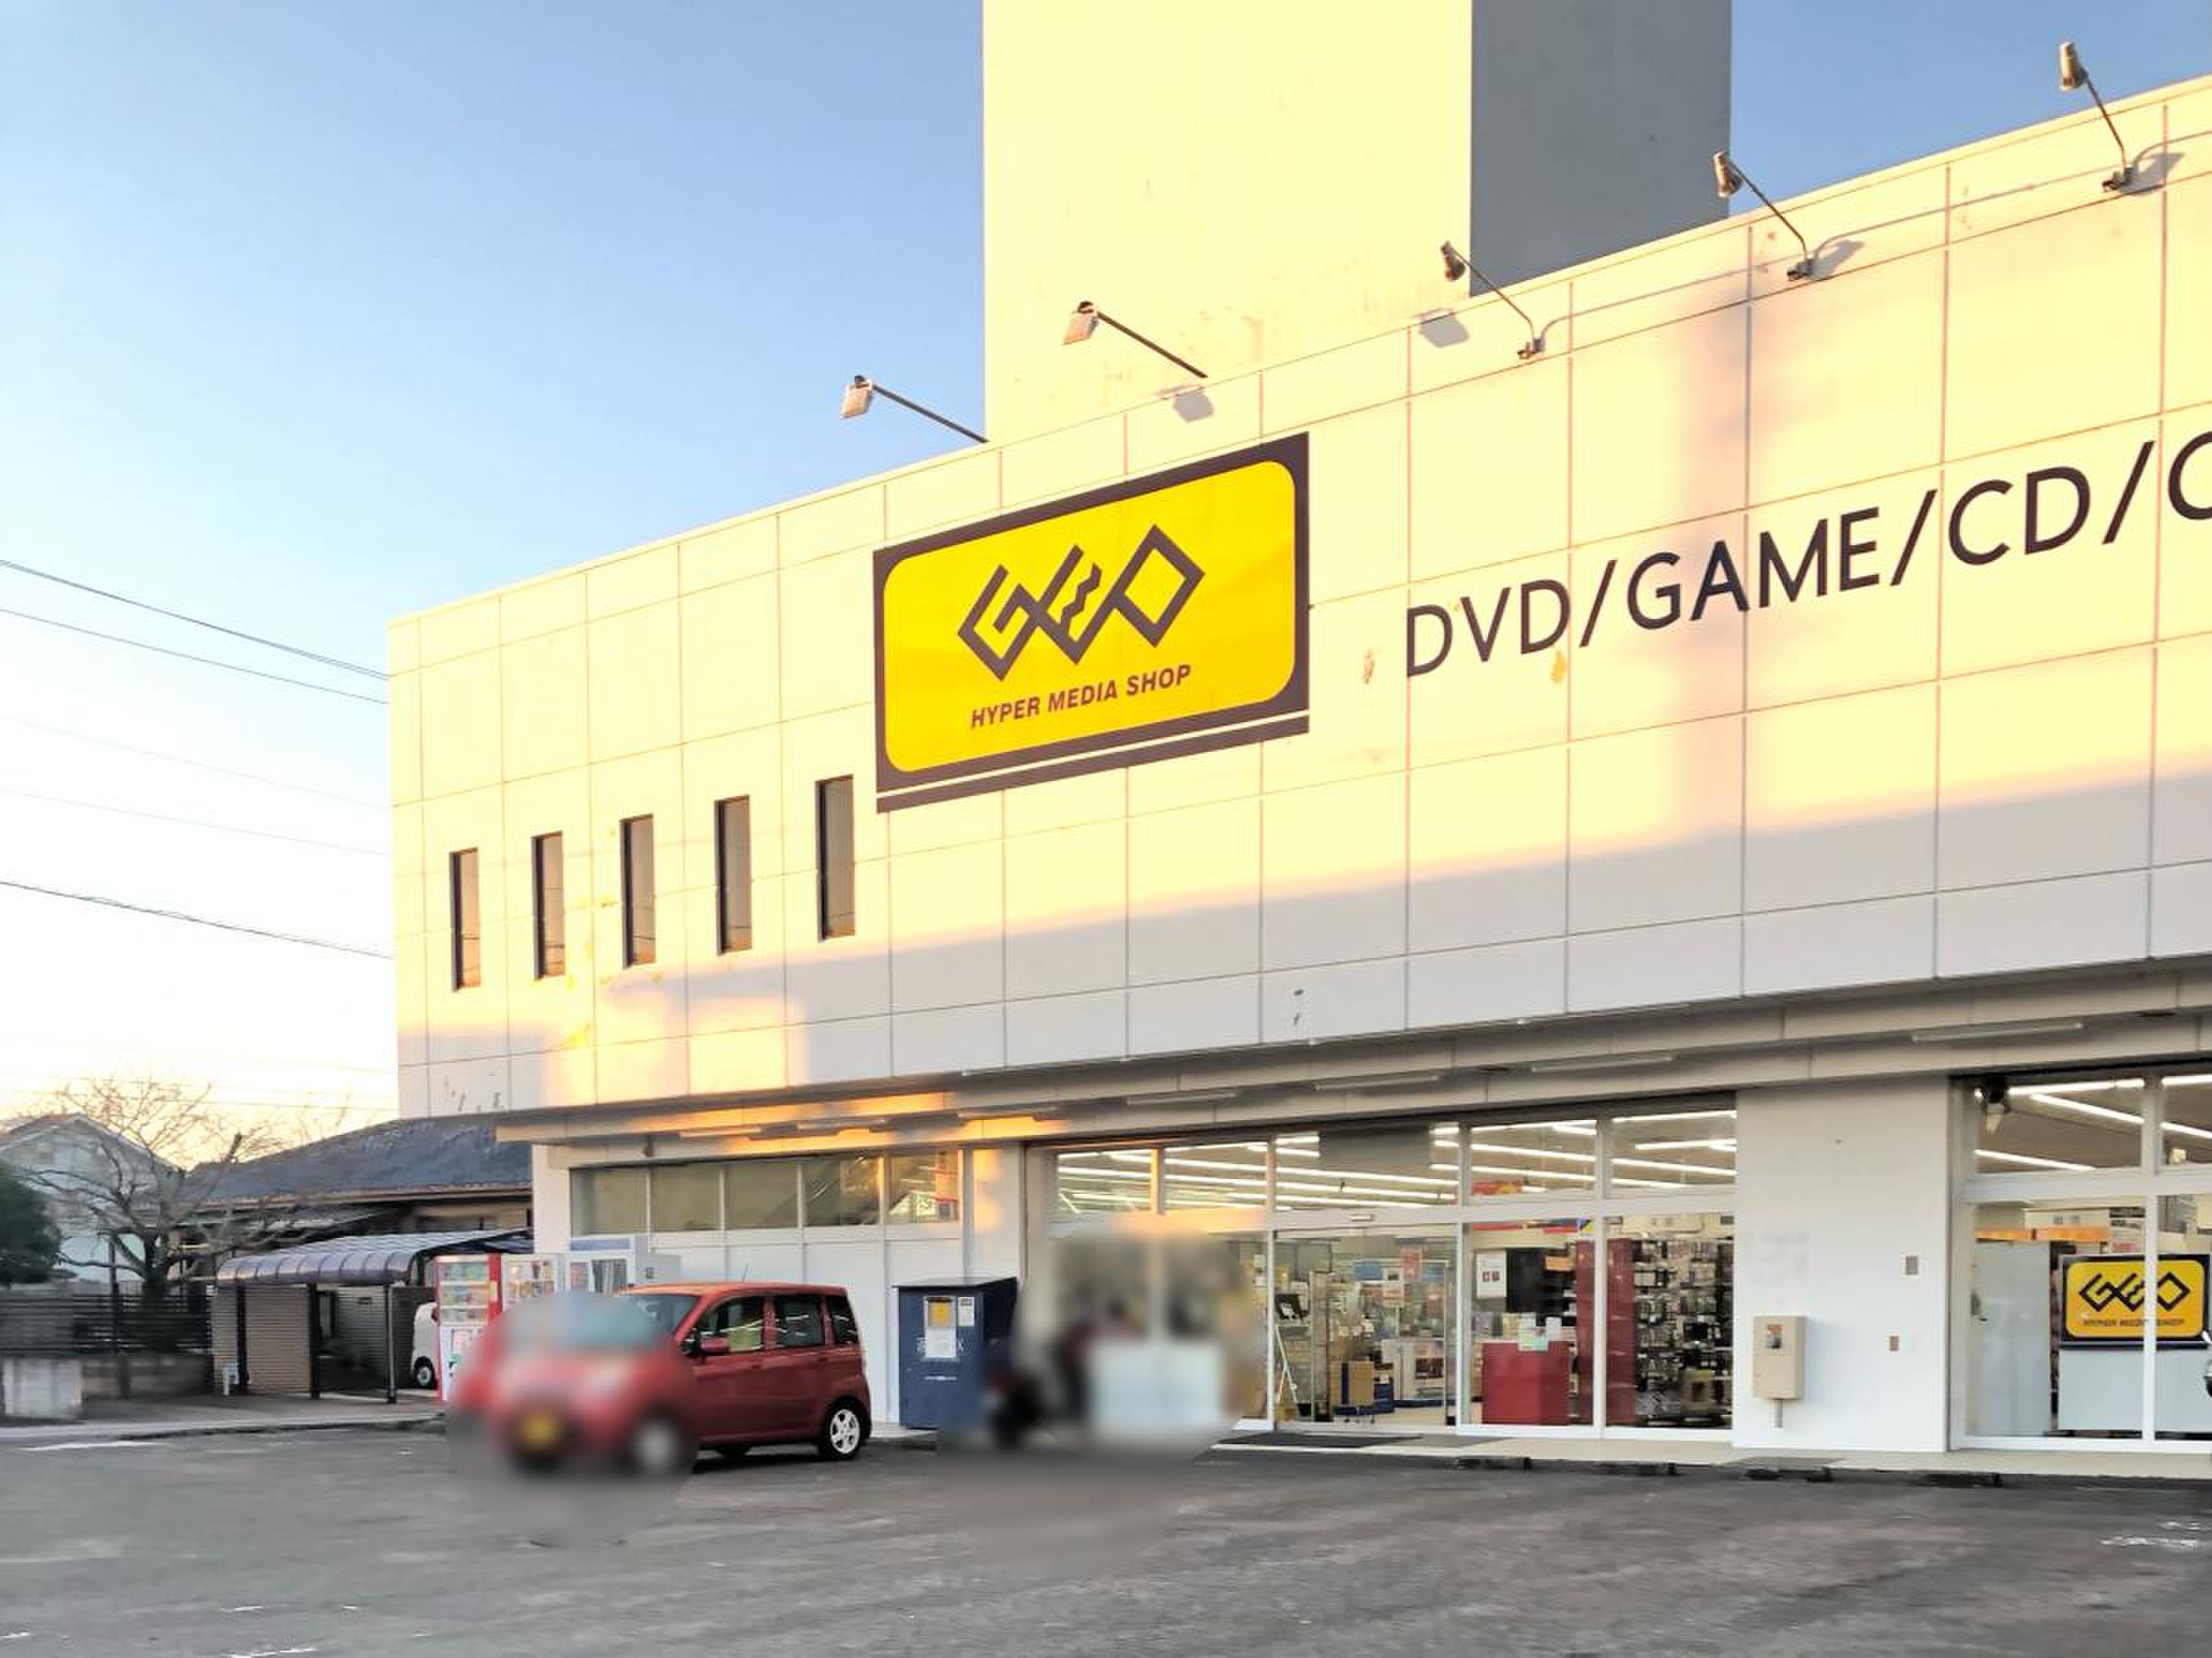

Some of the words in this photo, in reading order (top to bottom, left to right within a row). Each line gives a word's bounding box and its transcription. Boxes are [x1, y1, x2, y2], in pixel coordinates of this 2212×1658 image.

[958, 524, 1205, 682] GEO
[972, 696, 1041, 729] HYPER
[1047, 680, 1118, 712] MEDIA
[1125, 664, 1191, 696] SHOP
